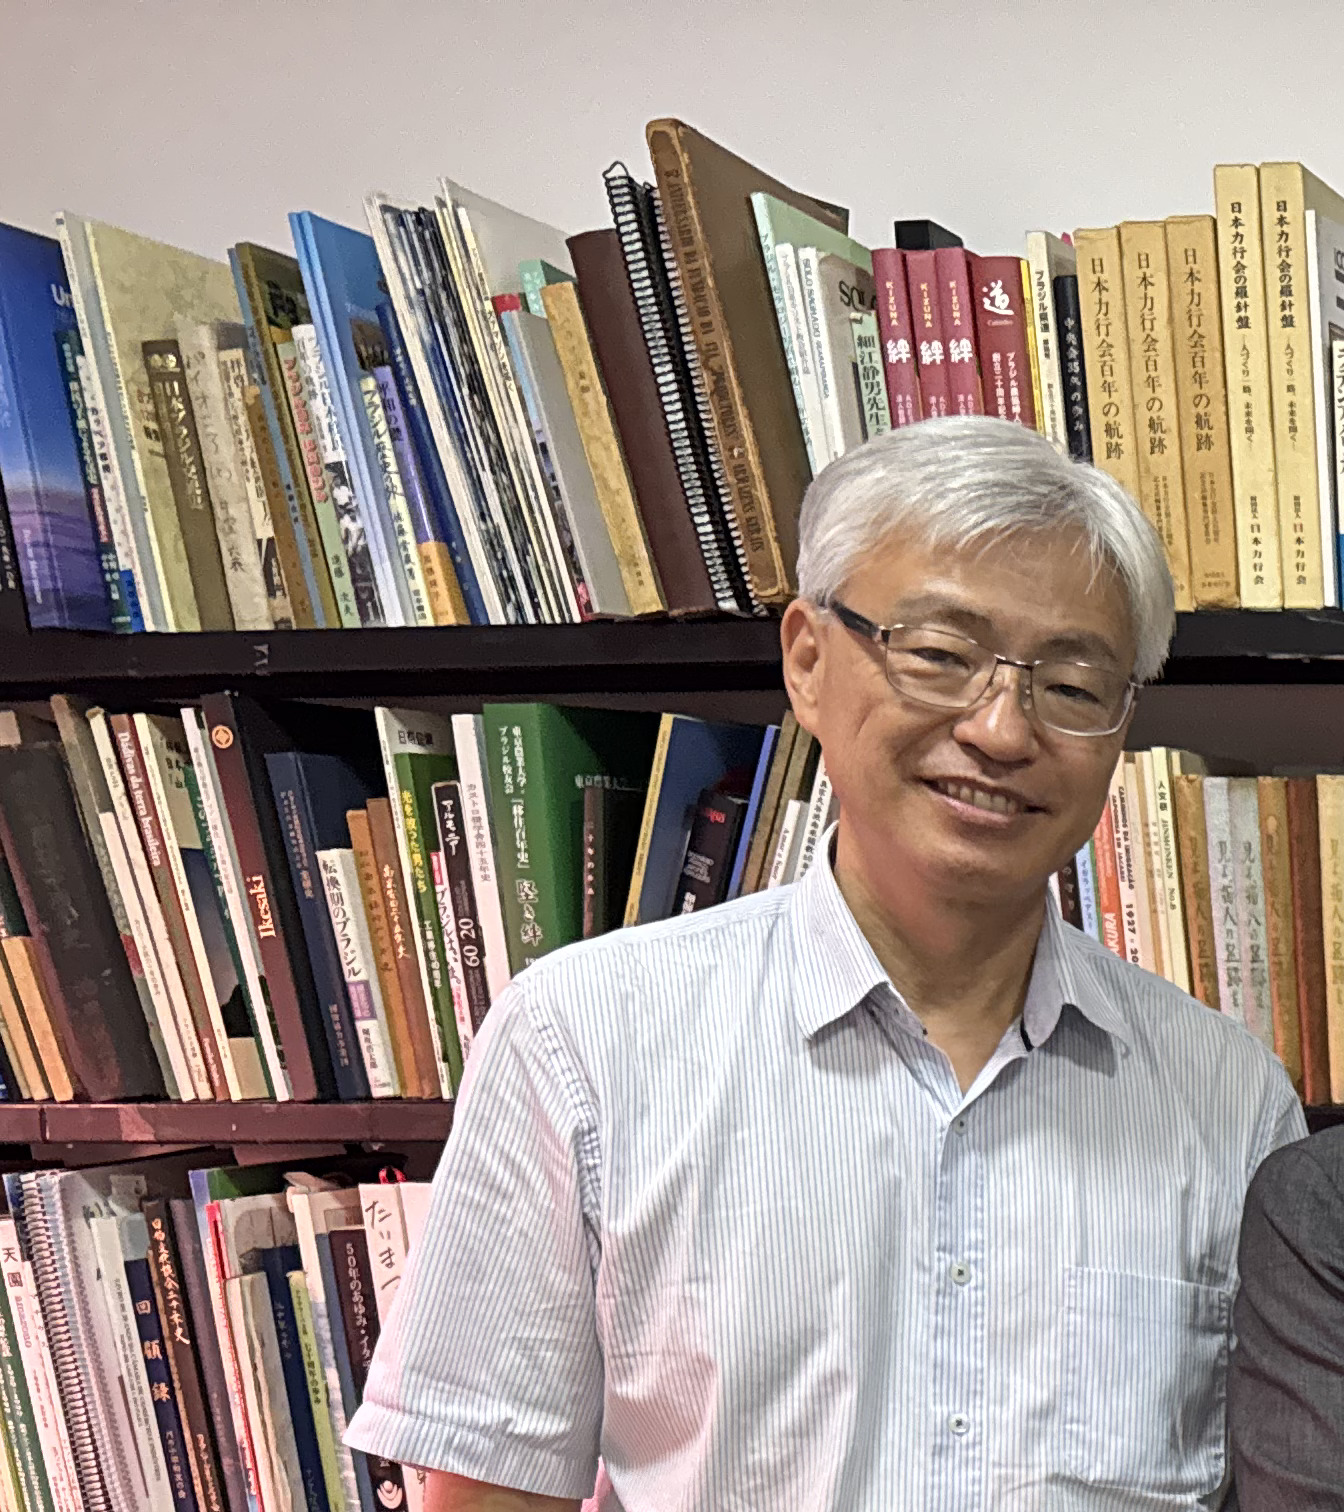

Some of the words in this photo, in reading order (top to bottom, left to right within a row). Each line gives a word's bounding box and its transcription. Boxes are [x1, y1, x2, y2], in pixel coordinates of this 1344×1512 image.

[1230, 202, 1252, 330] 日本力行会の羅針盤
[1275, 200, 1296, 330] 日本力行会の羅針盤
[886, 281, 899, 326] KIZUNA
[920, 283, 932, 328] KIZUNA
[949, 281, 961, 326] KIZUNA
[982, 280, 1014, 315] 道
[886, 339, 911, 364] 絆
[920, 340, 944, 364] 絆
[949, 338, 973, 363] 絆
[1090, 257, 1125, 460] 日本力行会百年の航跡
[1137, 253, 1167, 456] 日本力行会百年の航跡
[1183, 248, 1214, 452] 日本力行会百年の航跡
[1250, 523, 1264, 585] 日本力行会
[1294, 522, 1307, 585] 日本力行会
[131, 788, 152, 816] terra
[139, 815, 166, 866] brasileira
[246, 874, 276, 939] Ikesaki
[323, 861, 361, 978] 転換期のブラジル
[1125, 903, 1136, 935] 1927
